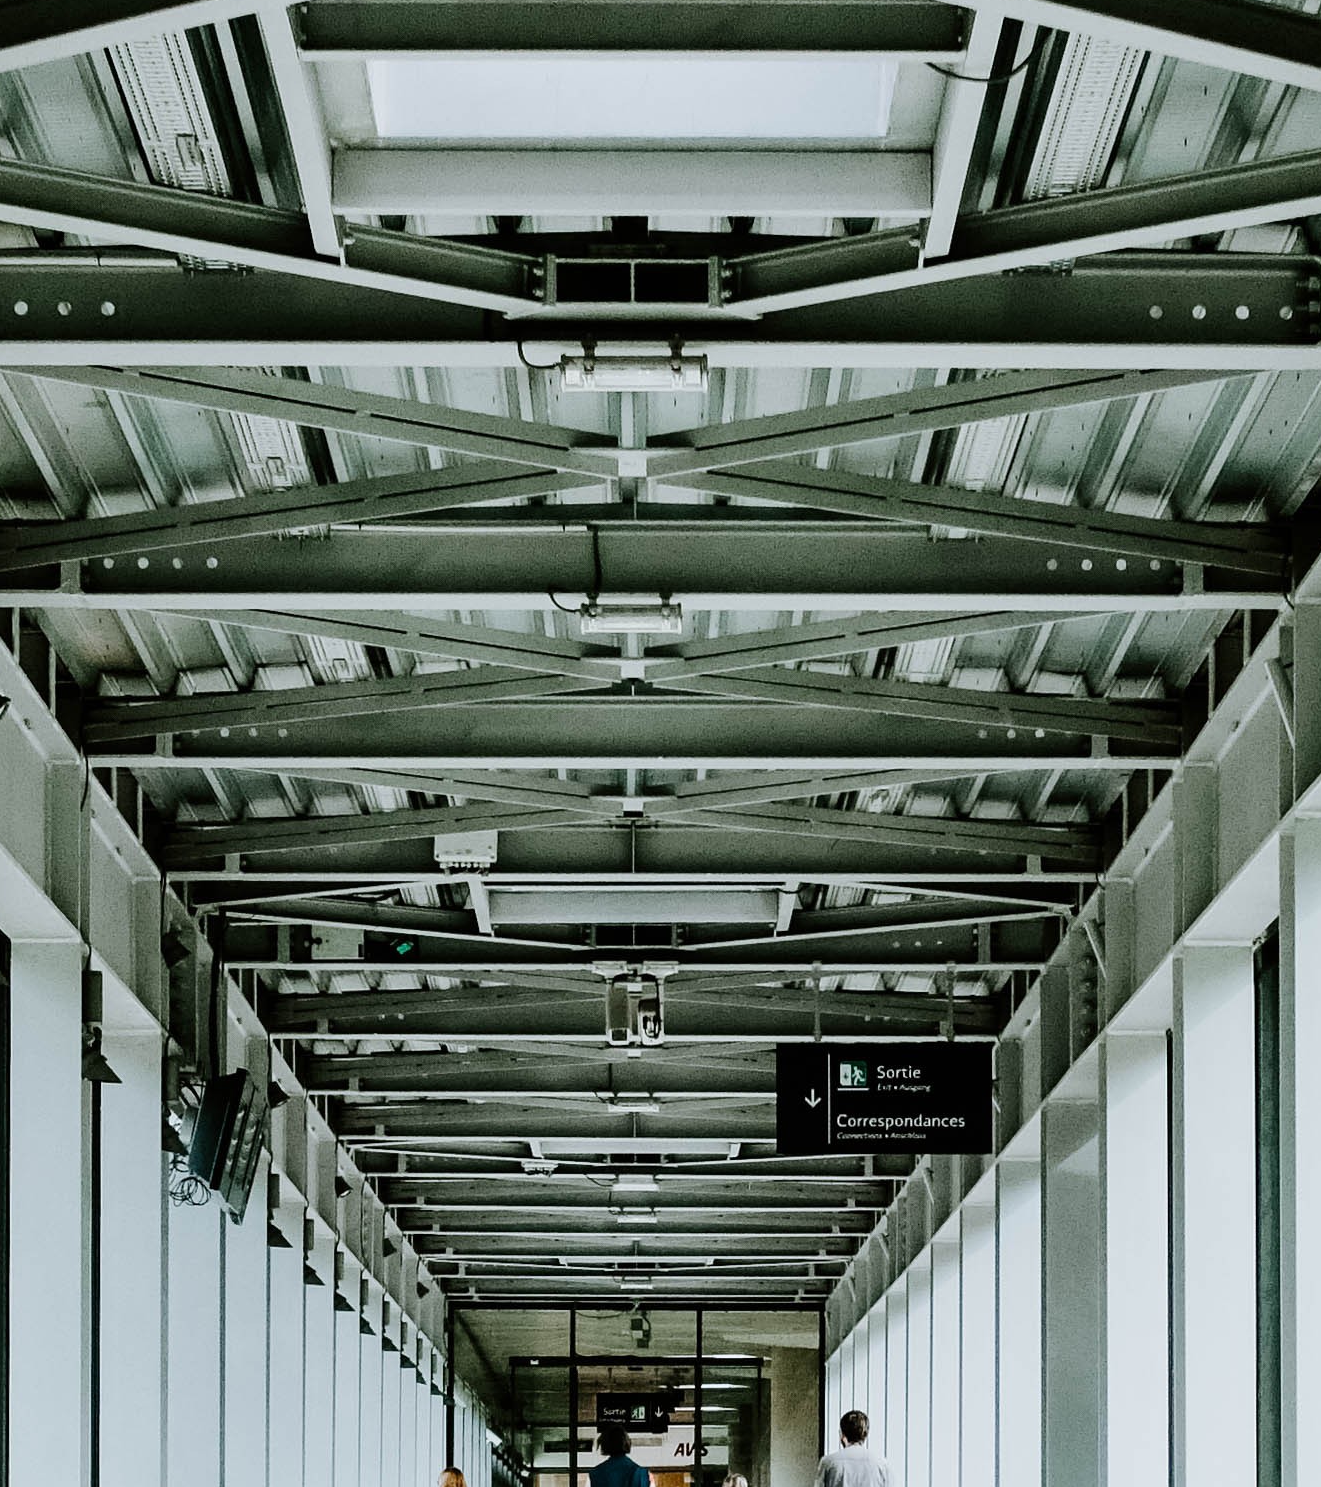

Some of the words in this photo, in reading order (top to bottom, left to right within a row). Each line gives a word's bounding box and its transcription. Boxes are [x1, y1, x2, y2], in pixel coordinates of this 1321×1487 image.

[876, 1065, 921, 1079] Sortie
[836, 1113, 966, 1130] Correspondances
[674, 1443, 710, 1458] AVS
